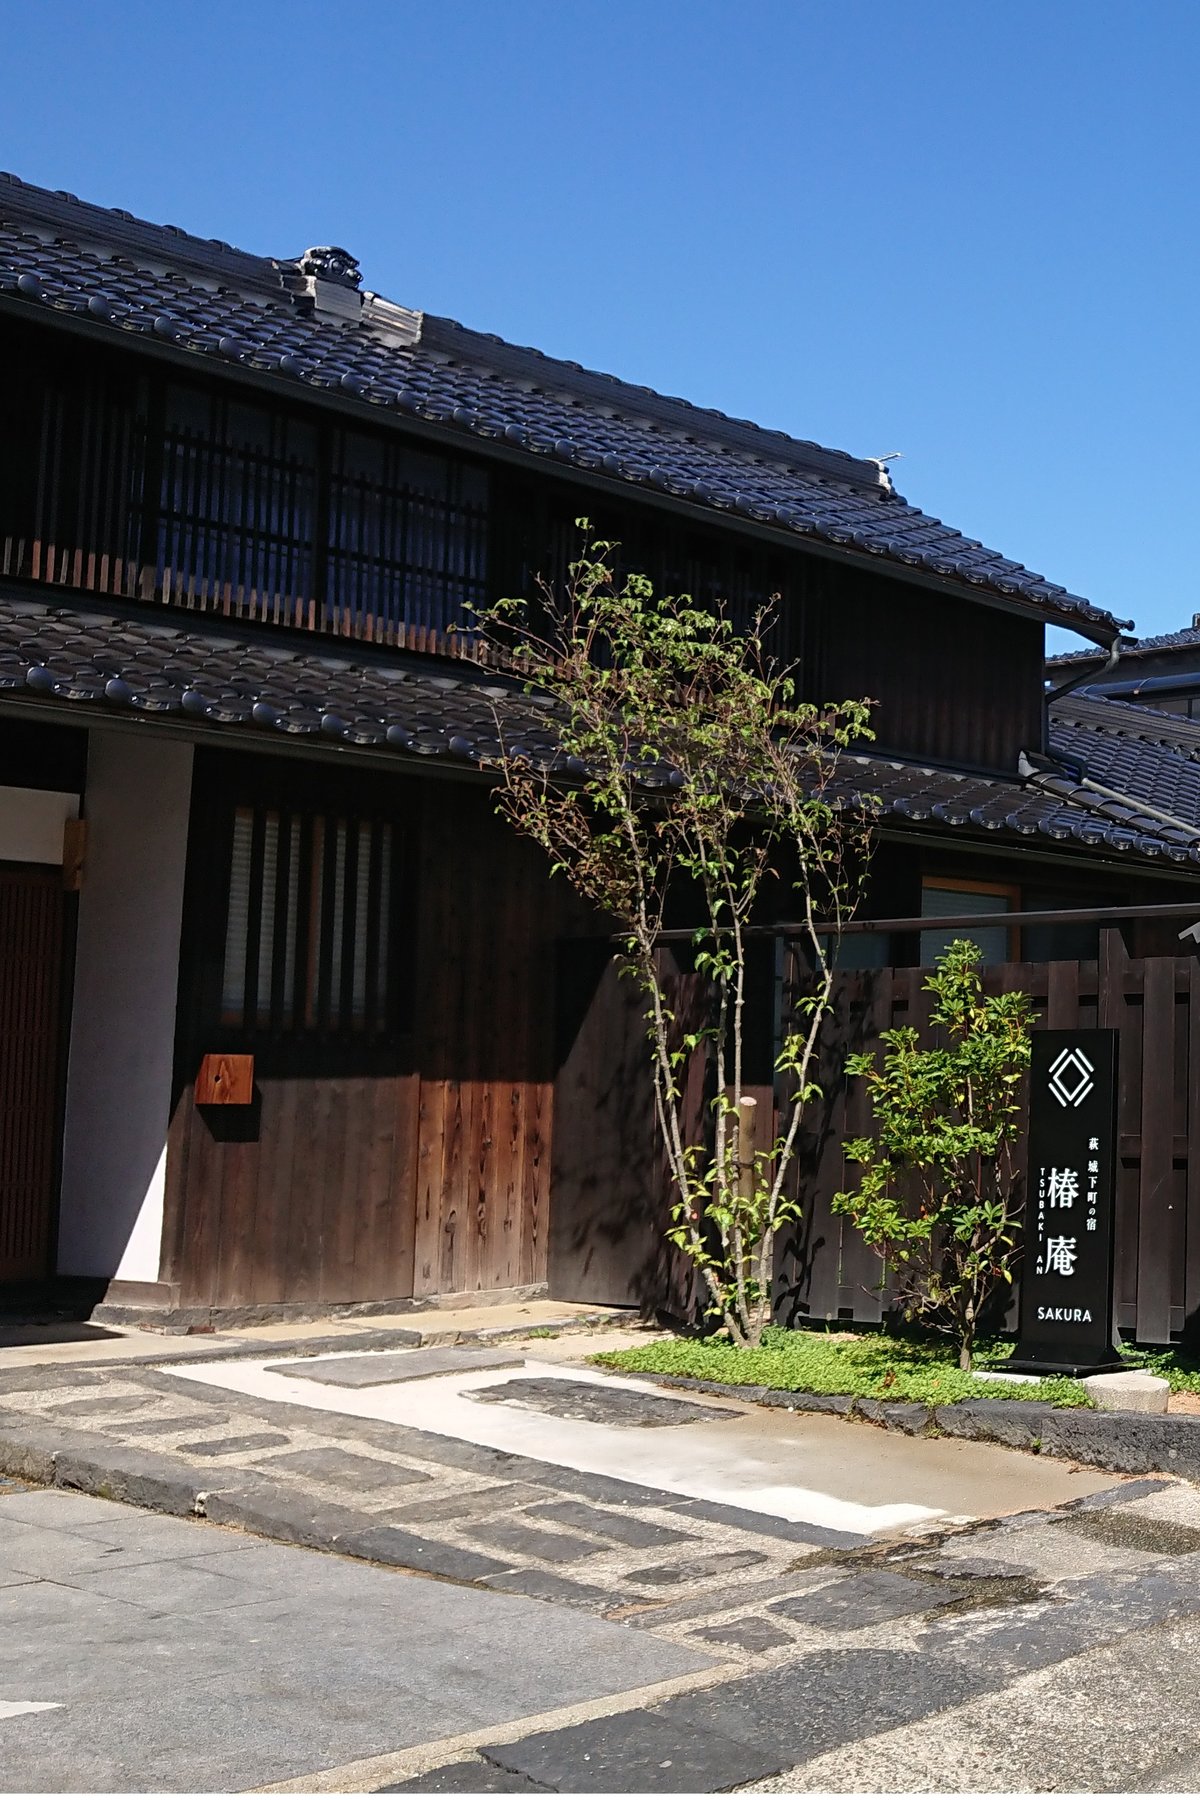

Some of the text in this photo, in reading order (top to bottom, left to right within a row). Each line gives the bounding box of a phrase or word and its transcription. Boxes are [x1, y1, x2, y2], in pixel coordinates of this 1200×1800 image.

[1086, 1137, 1099, 1231] 萩 城下町の宿
[1045, 1167, 1080, 1276] 椿庵
[1036, 1255, 1043, 1275] AN
[1037, 1306, 1092, 1323] SAKURA
